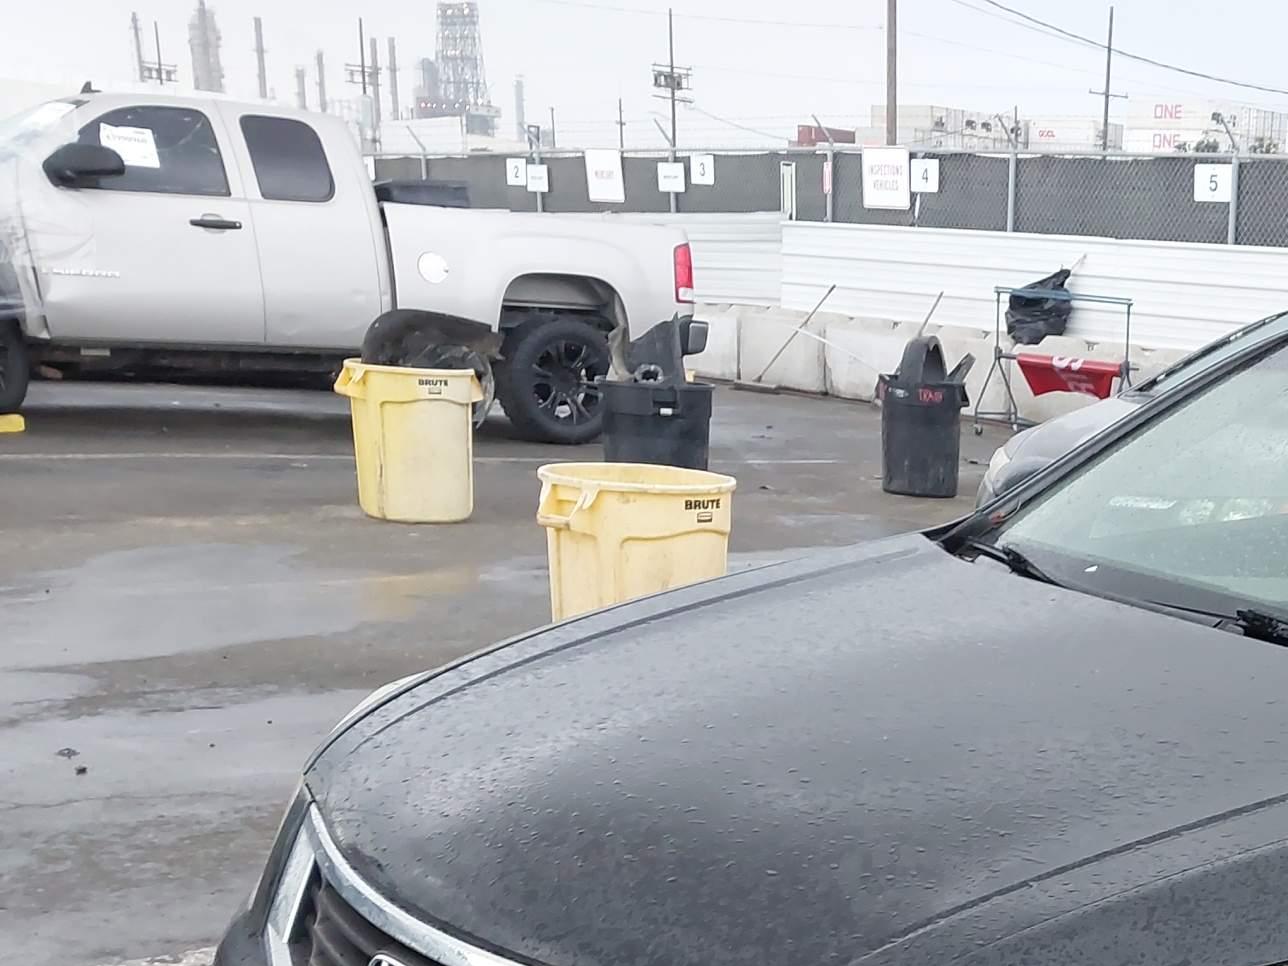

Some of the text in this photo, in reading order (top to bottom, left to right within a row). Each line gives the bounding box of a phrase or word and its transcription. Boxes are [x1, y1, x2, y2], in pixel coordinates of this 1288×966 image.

[1154, 103, 1183, 119] ONE
[1152, 134, 1179, 148] ONE
[514, 165, 520, 178] 2
[699, 161, 706, 177] 3
[921, 166, 929, 184] 4
[1208, 174, 1219, 192] 5
[684, 498, 721, 511] BRUTE
